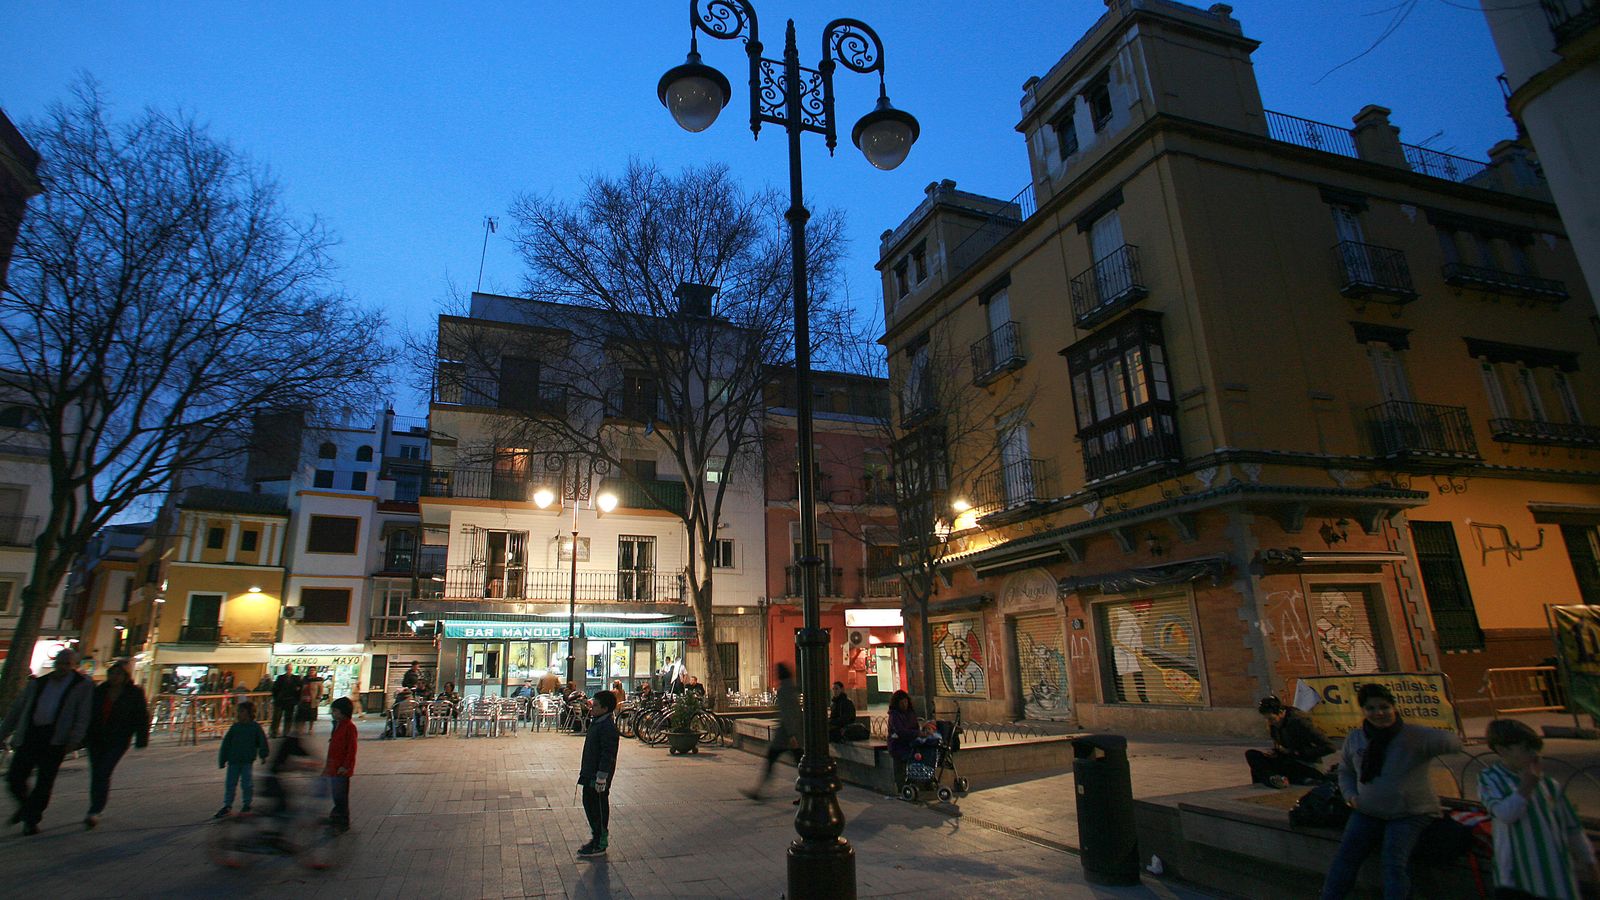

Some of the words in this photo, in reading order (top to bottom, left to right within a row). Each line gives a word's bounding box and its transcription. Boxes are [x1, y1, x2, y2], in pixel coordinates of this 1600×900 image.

[465, 628, 494, 637] BAR
[502, 628, 561, 637] MANOLO
[276, 657, 318, 665] FLAMENCO
[332, 656, 360, 665] MAYO
[1395, 693, 1441, 704] hadas
